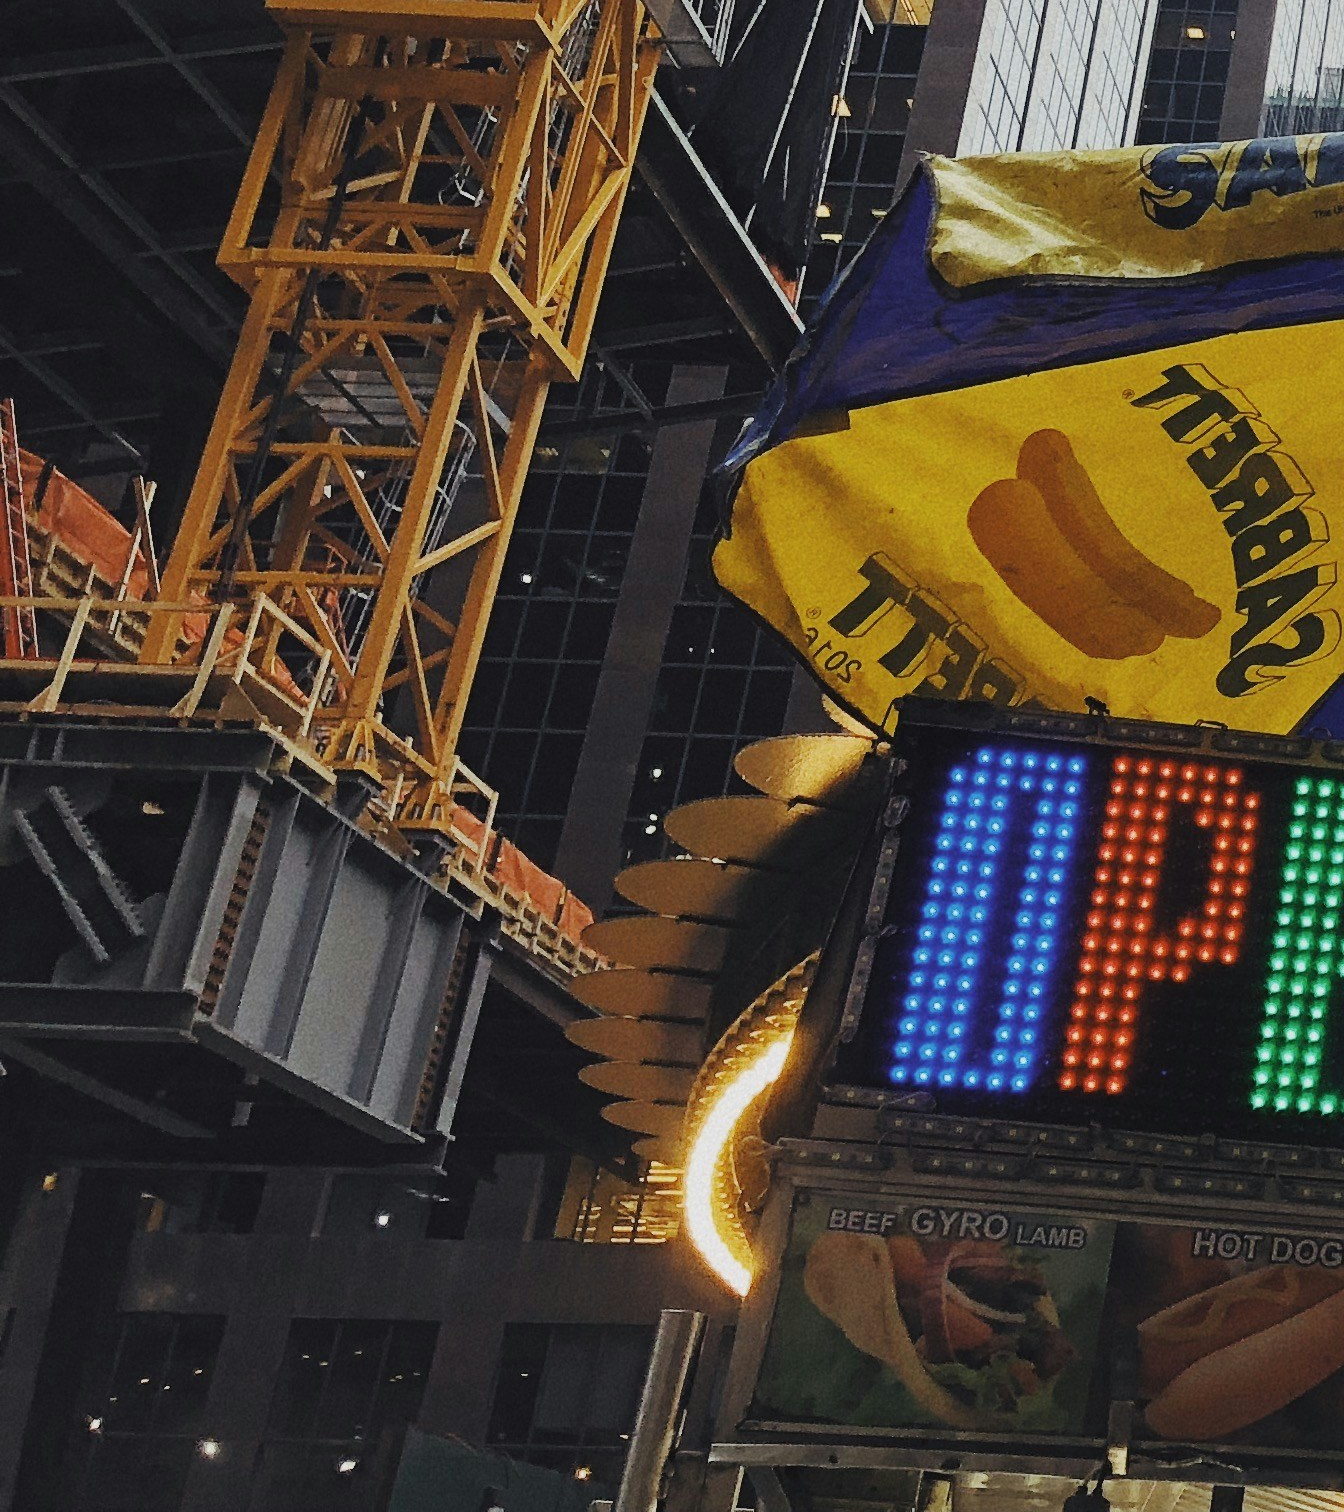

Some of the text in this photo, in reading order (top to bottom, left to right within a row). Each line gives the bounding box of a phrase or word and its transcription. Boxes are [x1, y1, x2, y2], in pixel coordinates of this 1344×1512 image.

[828, 1207, 1087, 1249] BEEF GYRO LAMB
[1192, 1231, 1264, 1260] HOT
